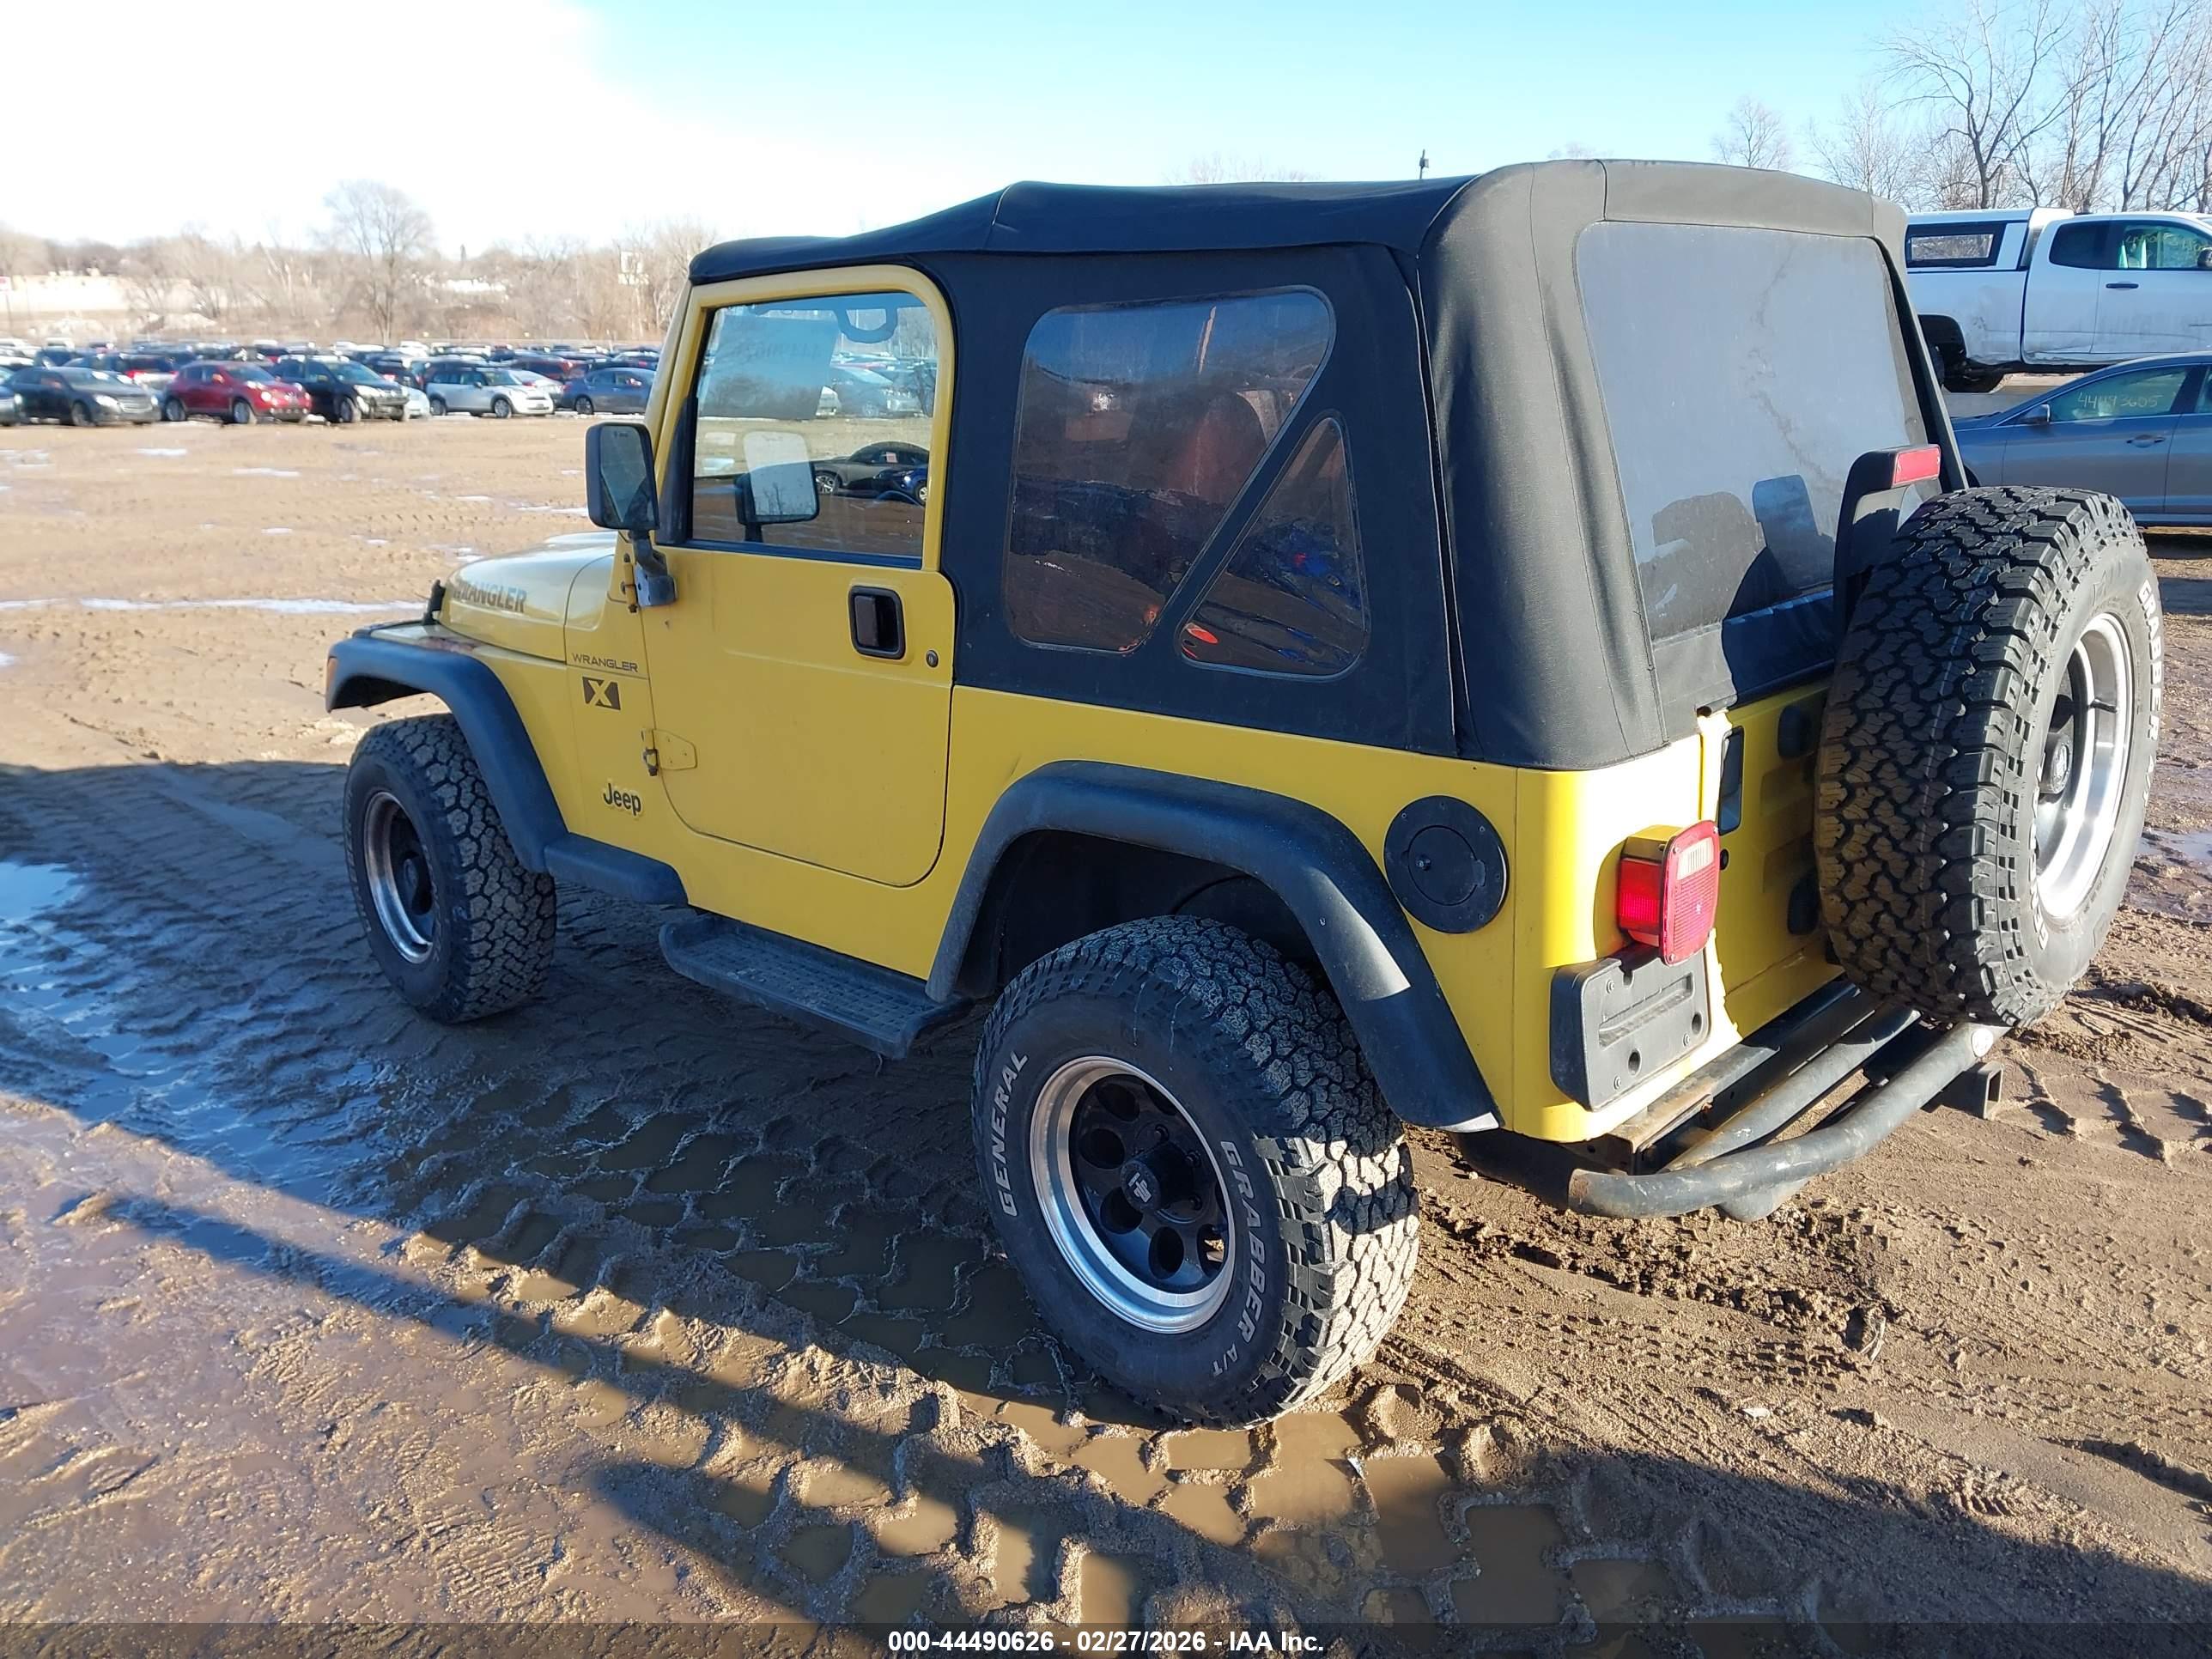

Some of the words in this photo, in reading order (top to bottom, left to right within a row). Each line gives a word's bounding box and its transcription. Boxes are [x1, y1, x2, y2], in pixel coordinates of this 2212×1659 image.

[573, 653, 638, 672] WRANGLER
[582, 677, 621, 710] X
[603, 782, 641, 816] Jeep
[992, 1051, 1028, 1217] GENERAL
[1220, 1140, 1265, 1343] GRABBER
[1212, 1343, 1238, 1377] A/T
